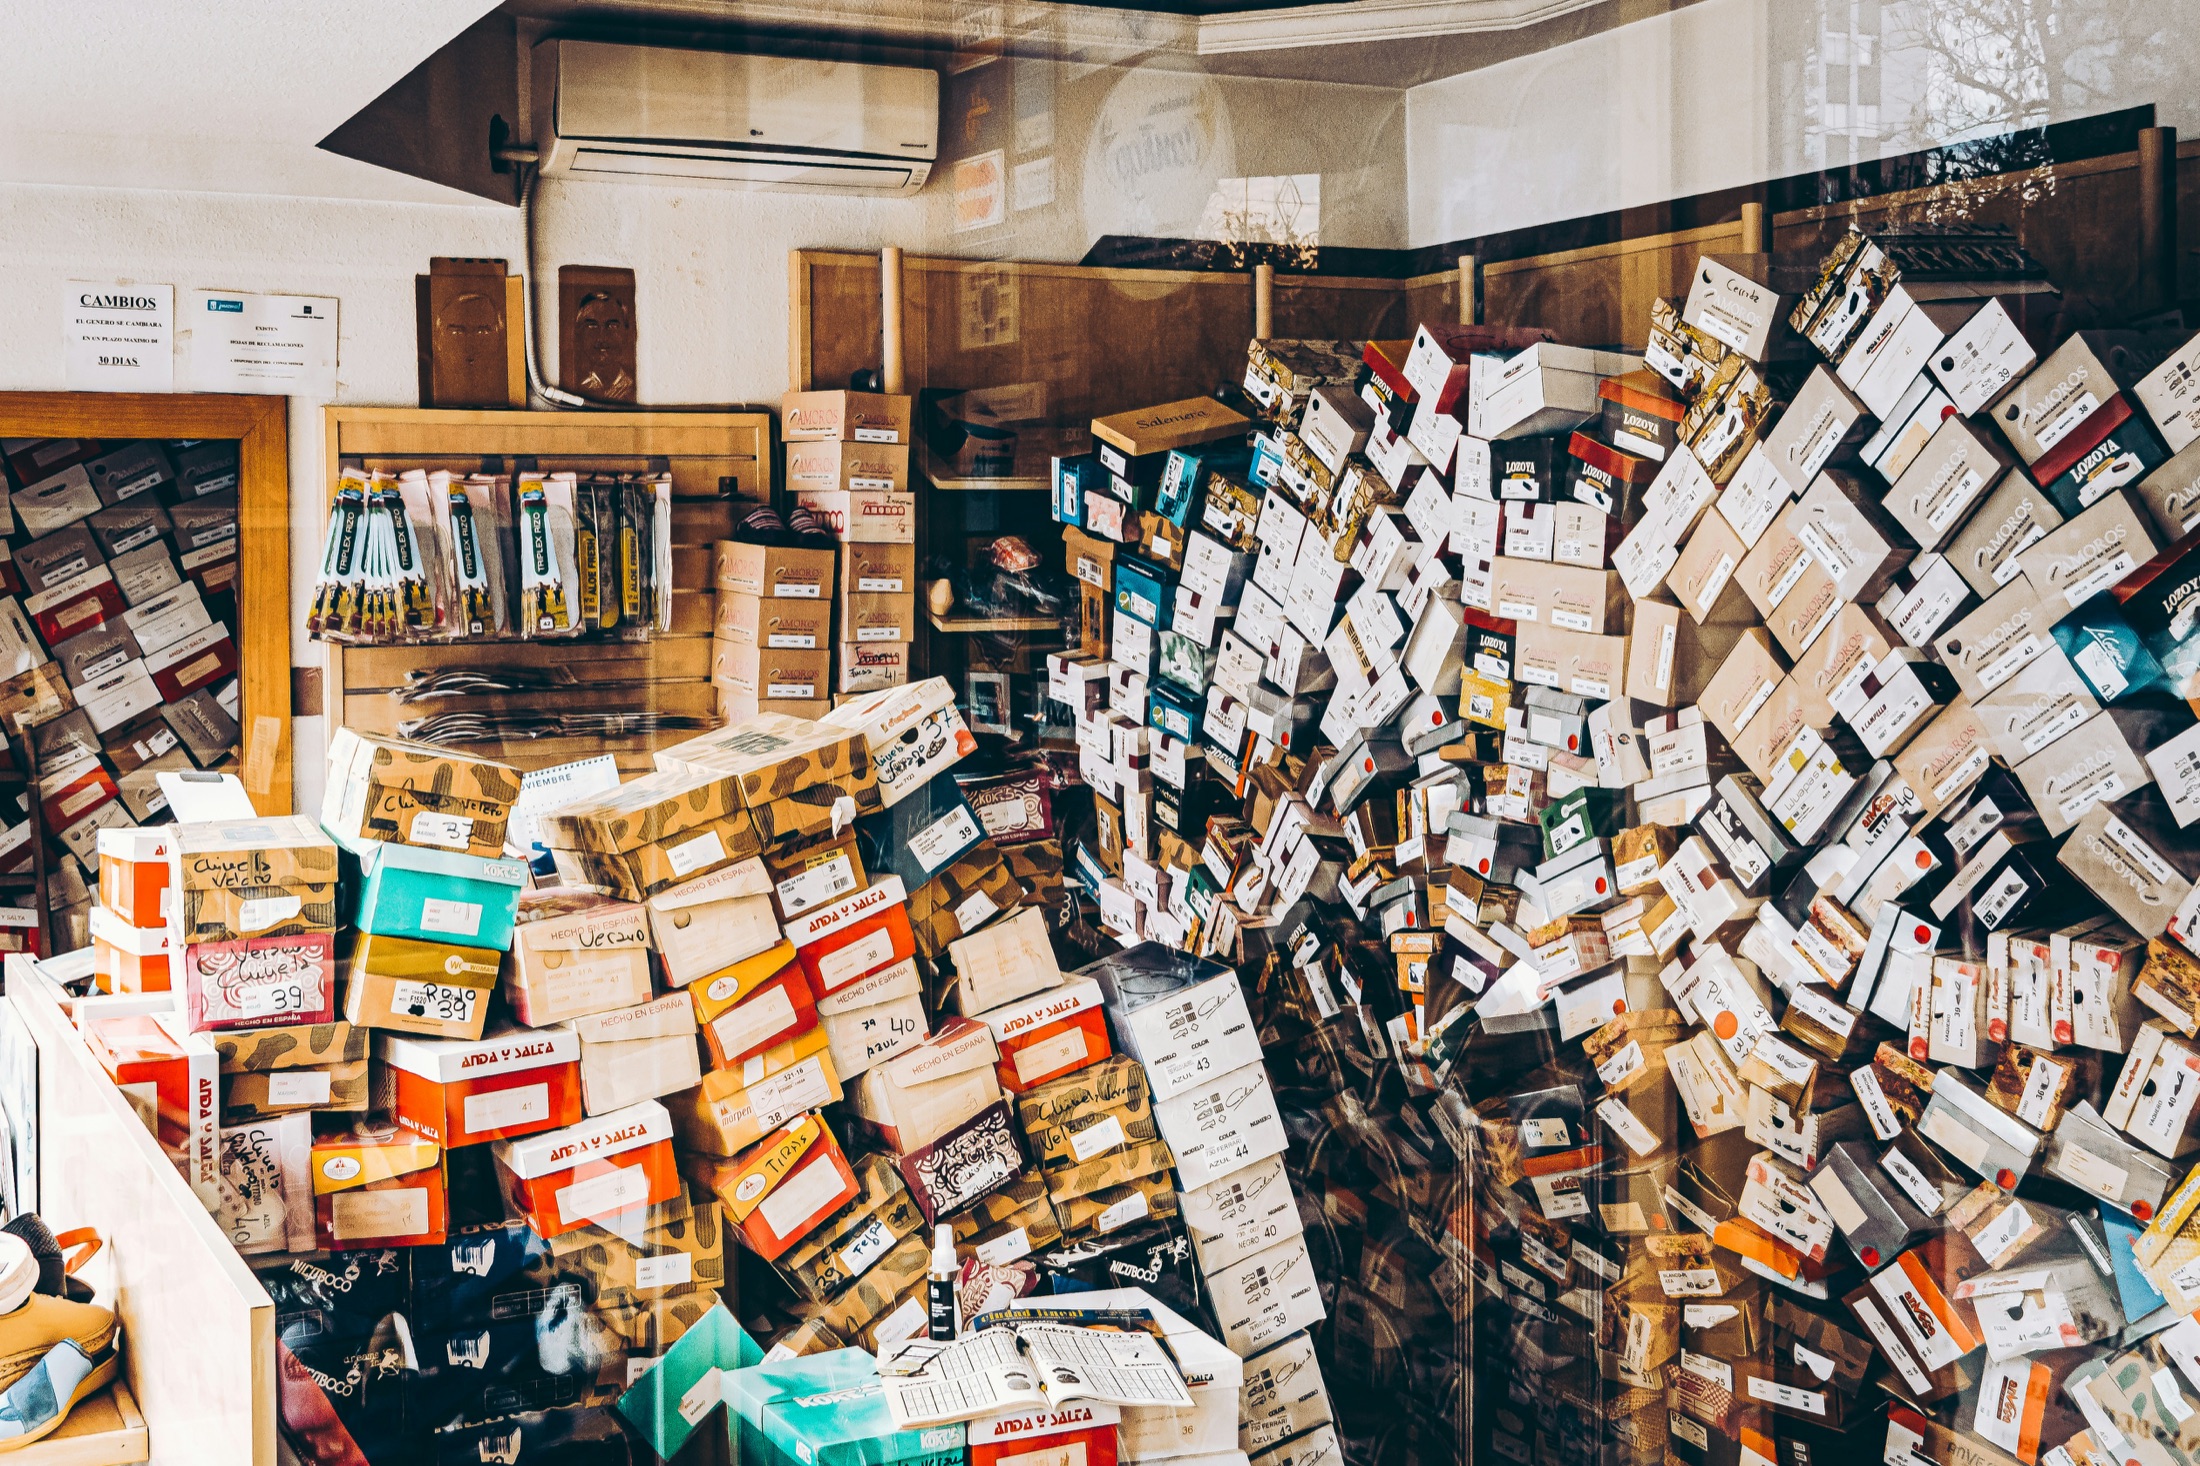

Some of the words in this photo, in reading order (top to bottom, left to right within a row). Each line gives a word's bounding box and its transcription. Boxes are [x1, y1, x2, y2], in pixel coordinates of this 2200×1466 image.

[80, 294, 156, 308] CAMBIOS
[99, 356, 109, 364] 30
[112, 357, 138, 365] DIAS
[1998, 367, 2011, 382] 39
[1370, 371, 1394, 401] LOZOYA
[2078, 404, 2089, 415] 38
[1623, 412, 1659, 436] LOZOYA
[1830, 431, 1839, 441] 43
[1506, 461, 1535, 475] LOZOYA
[2069, 439, 2121, 484] LOZOYA
[1581, 462, 1613, 486] LOZOYA
[1961, 479, 1971, 491] 36
[394, 509, 404, 528] RIZO
[534, 512, 542, 533] RIZO
[339, 536, 351, 571] TRIPLEX
[346, 512, 355, 533] RIZO
[398, 531, 409, 566] TRIPLEX
[463, 539, 473, 574] TRIPLEX
[536, 536, 545, 571] TRIPLEX
[587, 539, 596, 567] FRESH
[2114, 561, 2126, 571] 42
[588, 570, 596, 595] ALOE
[629, 568, 637, 593] ALOE
[2162, 574, 2200, 614] LOZOY
[1480, 634, 1508, 654] LOZOYA
[2024, 645, 2034, 656] 43
[1860, 660, 1869, 672] 38
[2069, 709, 2079, 720] 42
[1972, 756, 1982, 767] 38
[2103, 779, 2114, 790] 35
[959, 826, 972, 839] 39
[1748, 859, 1760, 874] 43
[673, 880, 705, 900] HECHO
[708, 875, 720, 888] EN
[721, 861, 757, 882] ESPAÑA
[808, 910, 839, 933] ANDA
[842, 906, 851, 919] Y
[852, 889, 887, 913] SALTA
[1984, 913, 1996, 925] 37
[551, 928, 585, 941] HECHO
[587, 924, 600, 933] EN
[602, 916, 640, 931] ESPAÑA
[1818, 948, 1827, 958] 40
[470, 964, 495, 973] WOMAN
[836, 987, 864, 1005] HECHO
[865, 981, 877, 993] EN
[878, 965, 908, 987] ESPAÑA
[272, 985, 301, 1009] 39
[274, 1014, 301, 1023] ESPAÑA
[438, 1000, 466, 1020] 39
[600, 1012, 634, 1028] HECHO
[636, 1010, 646, 1021] EN
[648, 999, 684, 1017] ESPAÑA
[1003, 1014, 1035, 1034] ANDA
[1038, 1009, 1044, 1022] Y
[1046, 996, 1081, 1016] SALTA
[1817, 1006, 1826, 1015] 37
[1954, 1005, 1961, 1017] 39
[891, 1018, 915, 1034] 40
[1154, 1052, 1177, 1066] MODELO
[1191, 1038, 1209, 1050] COLOR
[1223, 1023, 1245, 1036] NUMERO
[461, 1051, 498, 1069] ANDA
[502, 1048, 510, 1061] Y
[514, 1041, 555, 1059] SALTA
[912, 1057, 942, 1075] HECHO
[946, 1052, 957, 1063] EN
[958, 1034, 986, 1054] ESPAÑA
[1776, 1054, 1785, 1063] 40
[1171, 1072, 1194, 1086] AZUL
[1197, 1057, 1210, 1071] 43
[2036, 1090, 2044, 1101] 36
[2167, 1096, 2176, 1108] 40
[521, 1102, 533, 1112] 41
[1870, 1099, 1879, 1111] 35
[2149, 1100, 2163, 1127] VAQUERO
[722, 1105, 752, 1127] morpen
[768, 1112, 782, 1125] 38
[1619, 1120, 1629, 1130] 37
[550, 1141, 589, 1162] ANDA
[591, 1136, 601, 1149] Y
[604, 1124, 647, 1146] SALTA
[1182, 1143, 1205, 1157] MODELO
[1219, 1129, 1237, 1141] COLOR
[1250, 1114, 1272, 1127] NUMERO
[1209, 1156, 1231, 1169] AZUL
[1236, 1145, 1249, 1158] 44
[2101, 1183, 2113, 1193] 37
[1201, 1232, 1224, 1245] MODELO
[1237, 1235, 1260, 1250] NEGRO
[1264, 1224, 1278, 1239] 40
[2000, 1234, 2009, 1245] 40
[1252, 1329, 1273, 1342] AZUL
[1273, 1312, 1287, 1328] 39
[2018, 1333, 2028, 1341] 41
[1643, 1373, 1653, 1383] 31
[1714, 1376, 1726, 1386] 25
[994, 1416, 1033, 1436] ANDA
[1036, 1416, 1046, 1428] Y
[1051, 1407, 1093, 1425] SALTA
[1182, 1425, 1194, 1435] 36
[1252, 1433, 1274, 1445] AZUL
[1278, 1424, 1293, 1439] 43
